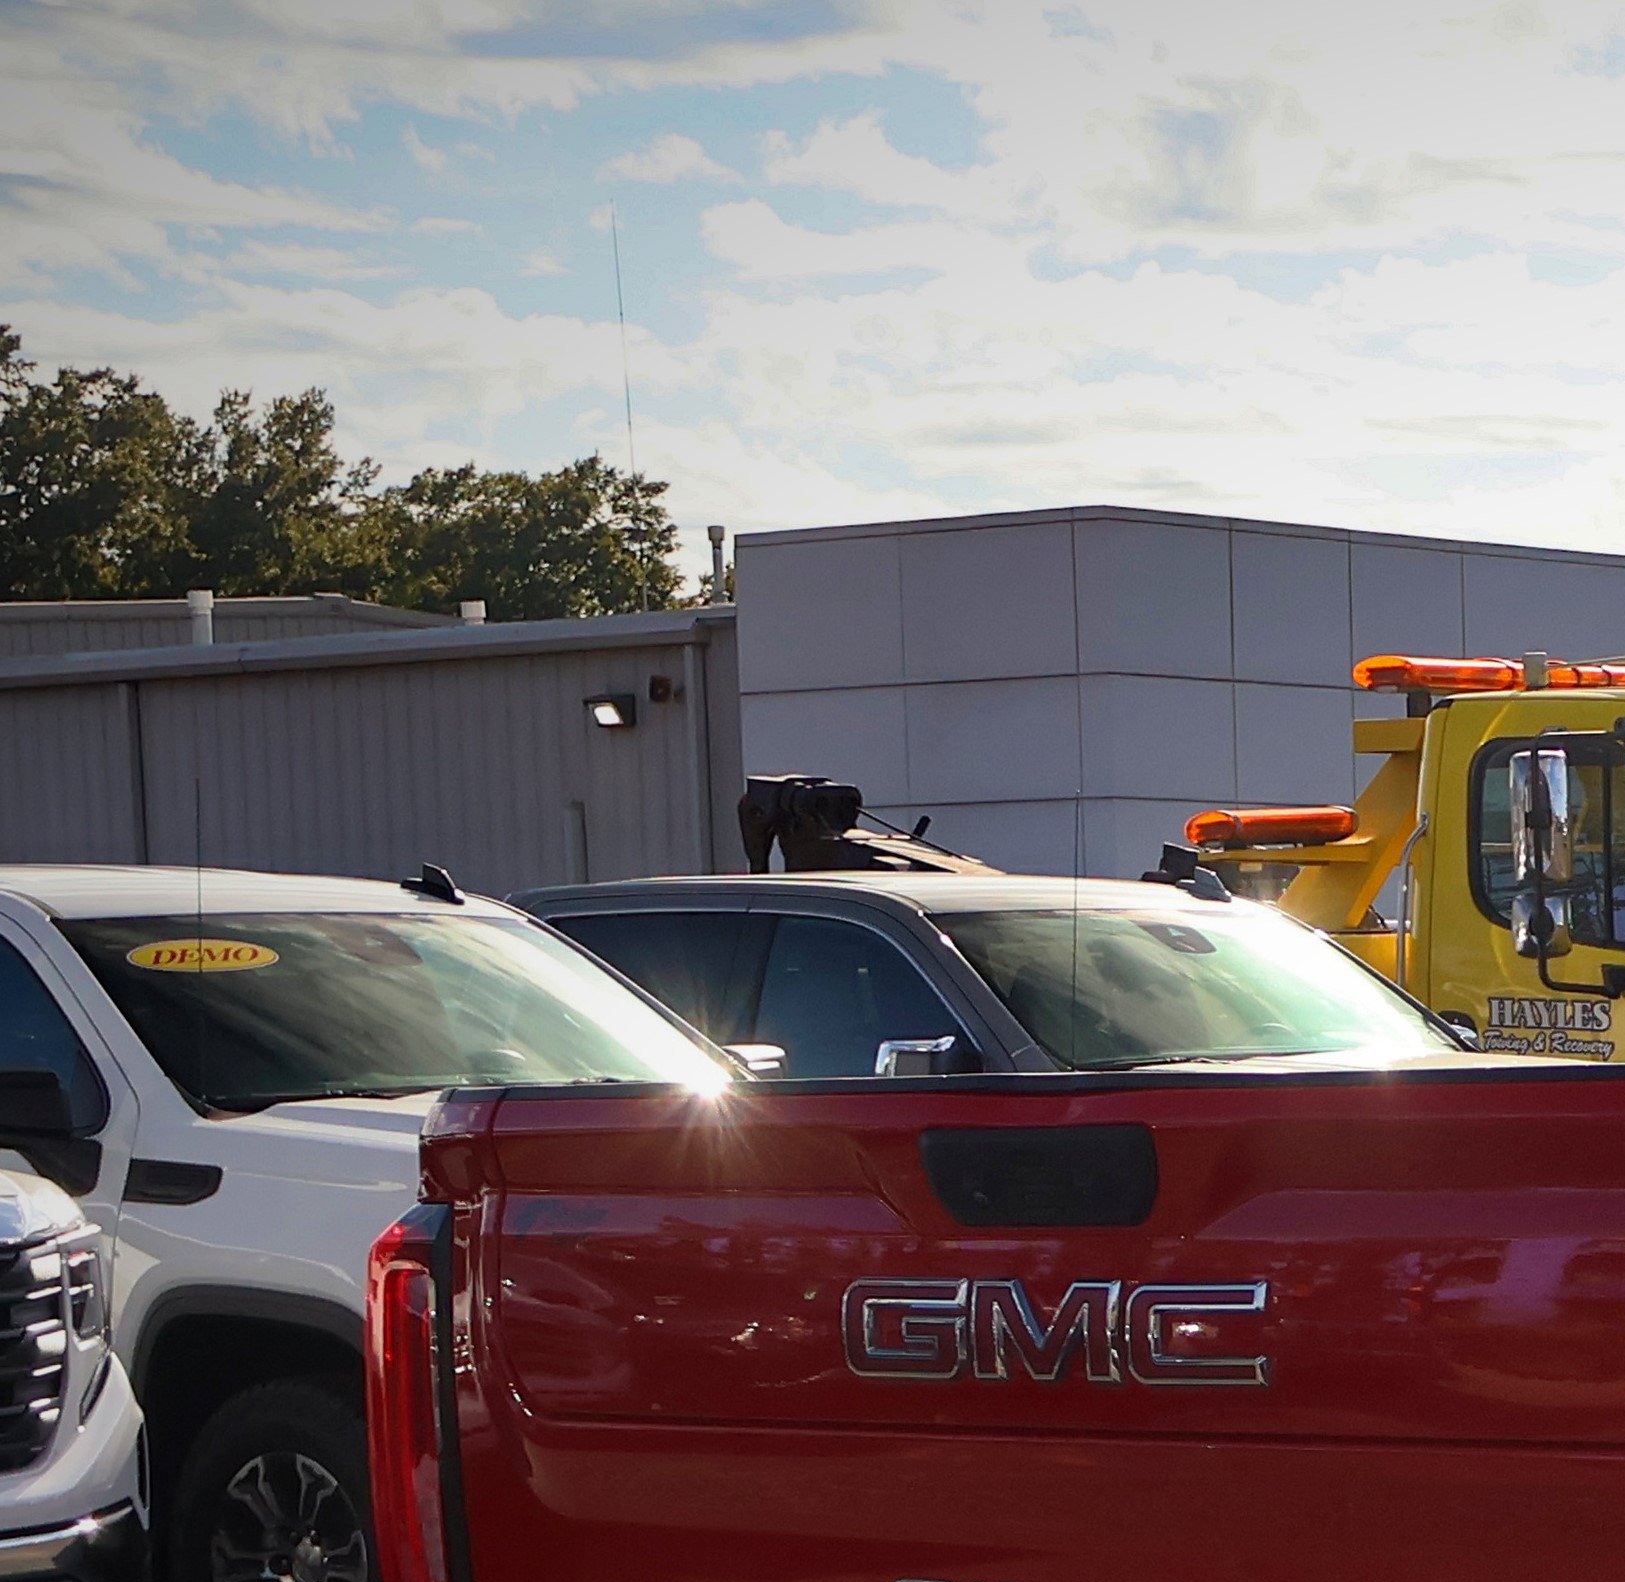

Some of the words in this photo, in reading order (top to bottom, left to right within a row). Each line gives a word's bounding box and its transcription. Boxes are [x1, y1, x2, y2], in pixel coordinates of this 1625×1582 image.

[151, 946, 260, 966] DEMO
[1488, 997, 1612, 1032] HAYLES
[1483, 1029, 1531, 1054] Towing
[1532, 1031, 1547, 1053] &
[1550, 1031, 1616, 1061] Recovery
[841, 1277, 1269, 1386] GMC
